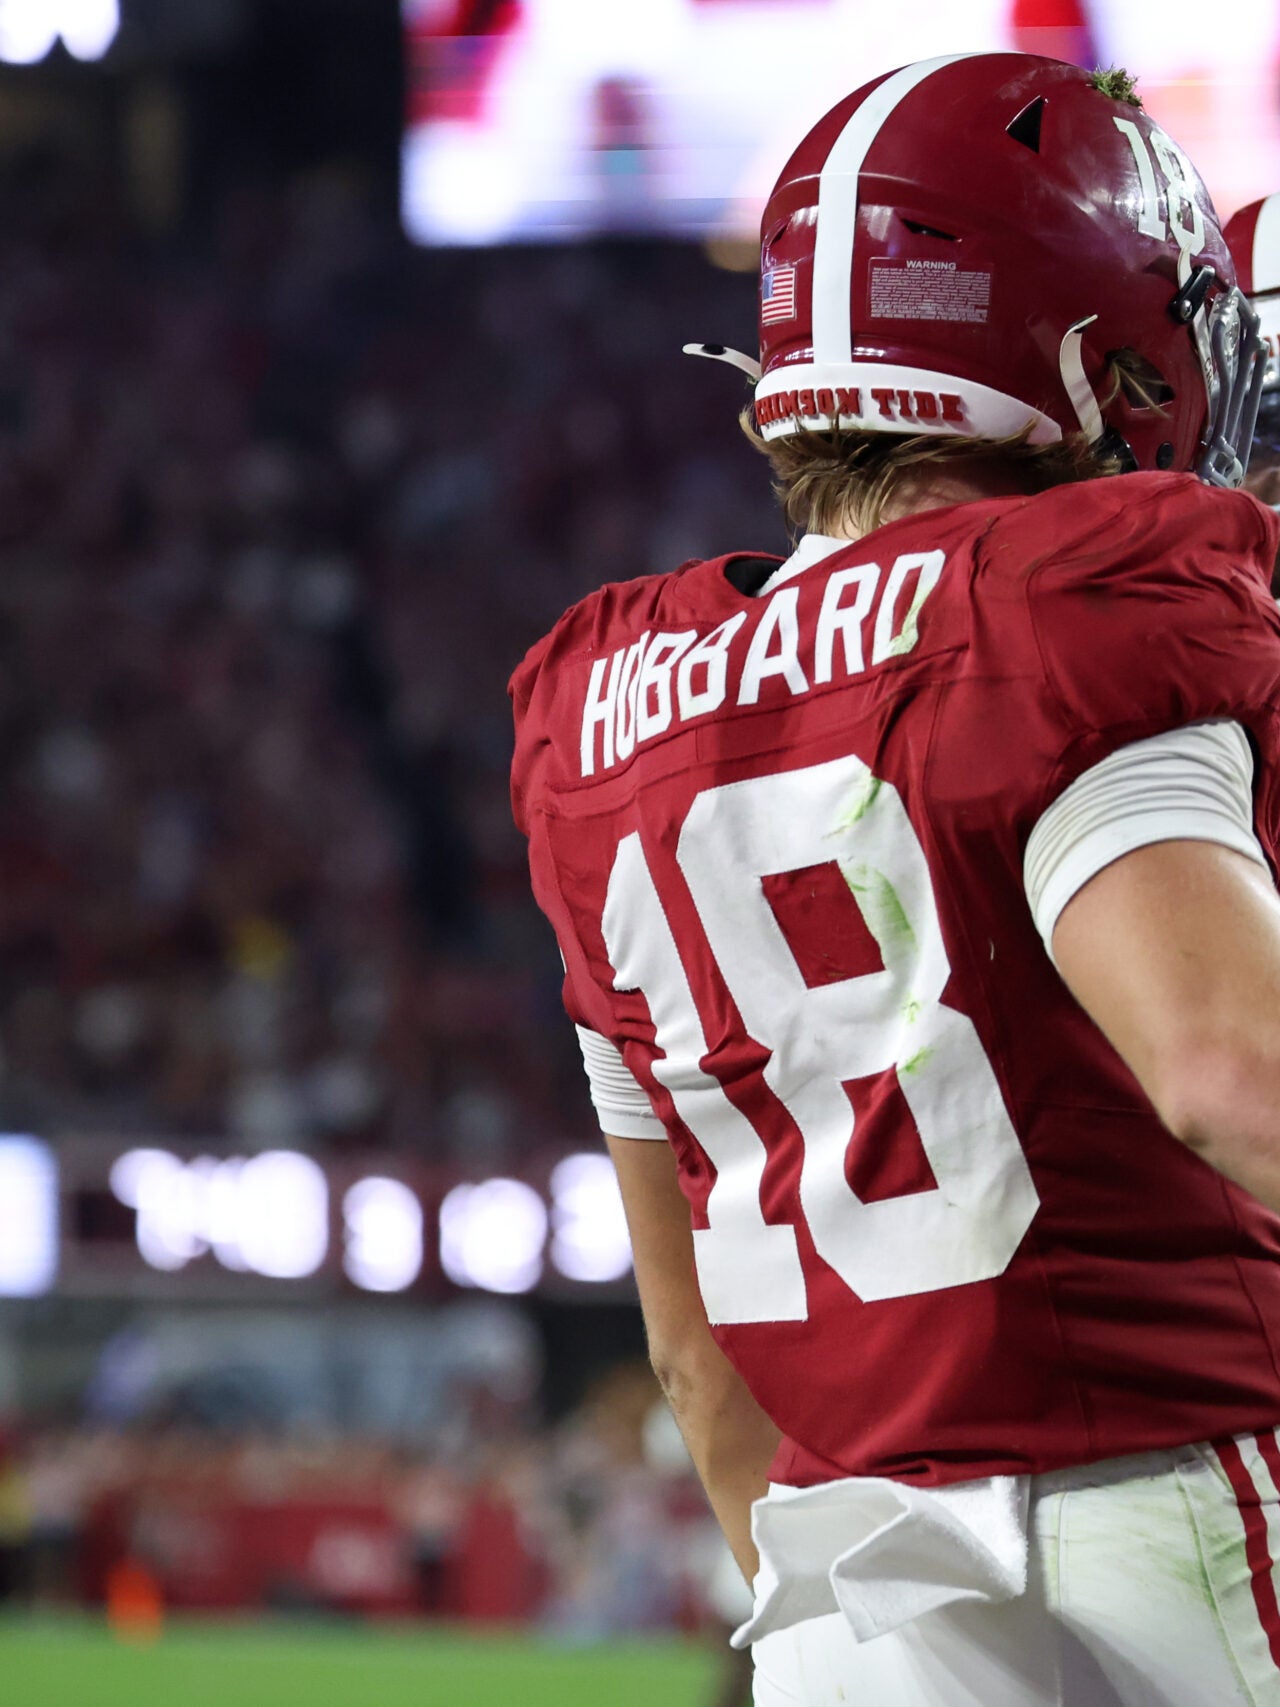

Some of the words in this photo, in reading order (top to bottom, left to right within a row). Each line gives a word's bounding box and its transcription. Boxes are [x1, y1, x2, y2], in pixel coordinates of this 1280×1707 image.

[1112, 116, 1205, 256] 18
[906, 260, 957, 271] WARNING
[755, 387, 861, 426] CRIMSON
[871, 387, 964, 422] TIDE
[580, 548, 946, 778] HUBBARD
[601, 753, 1041, 1325] 18
